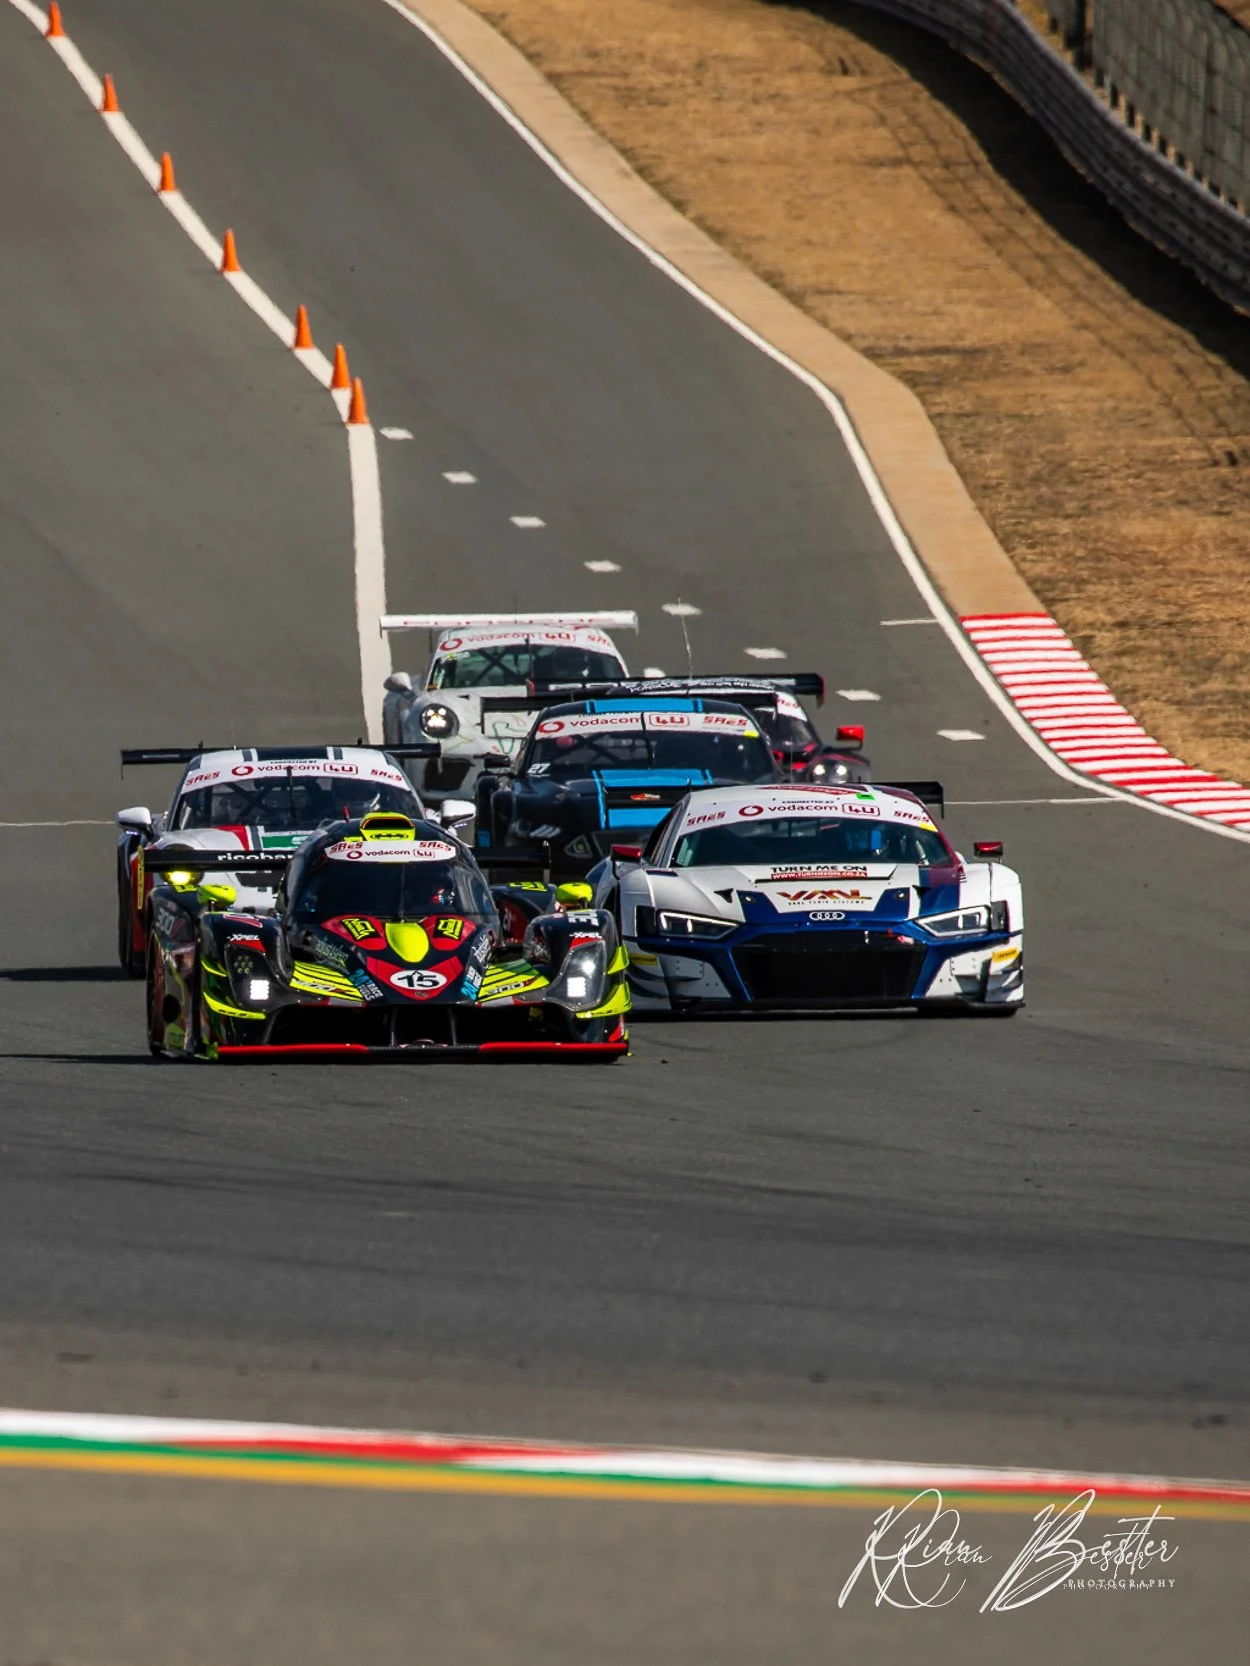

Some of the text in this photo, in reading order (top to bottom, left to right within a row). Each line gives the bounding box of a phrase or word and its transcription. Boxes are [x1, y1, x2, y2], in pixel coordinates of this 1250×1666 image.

[570, 716, 642, 727] vodacom
[257, 764, 321, 773] vodacom
[527, 763, 550, 774] 27
[768, 803, 839, 813] vodacom
[398, 974, 440, 988] 15
